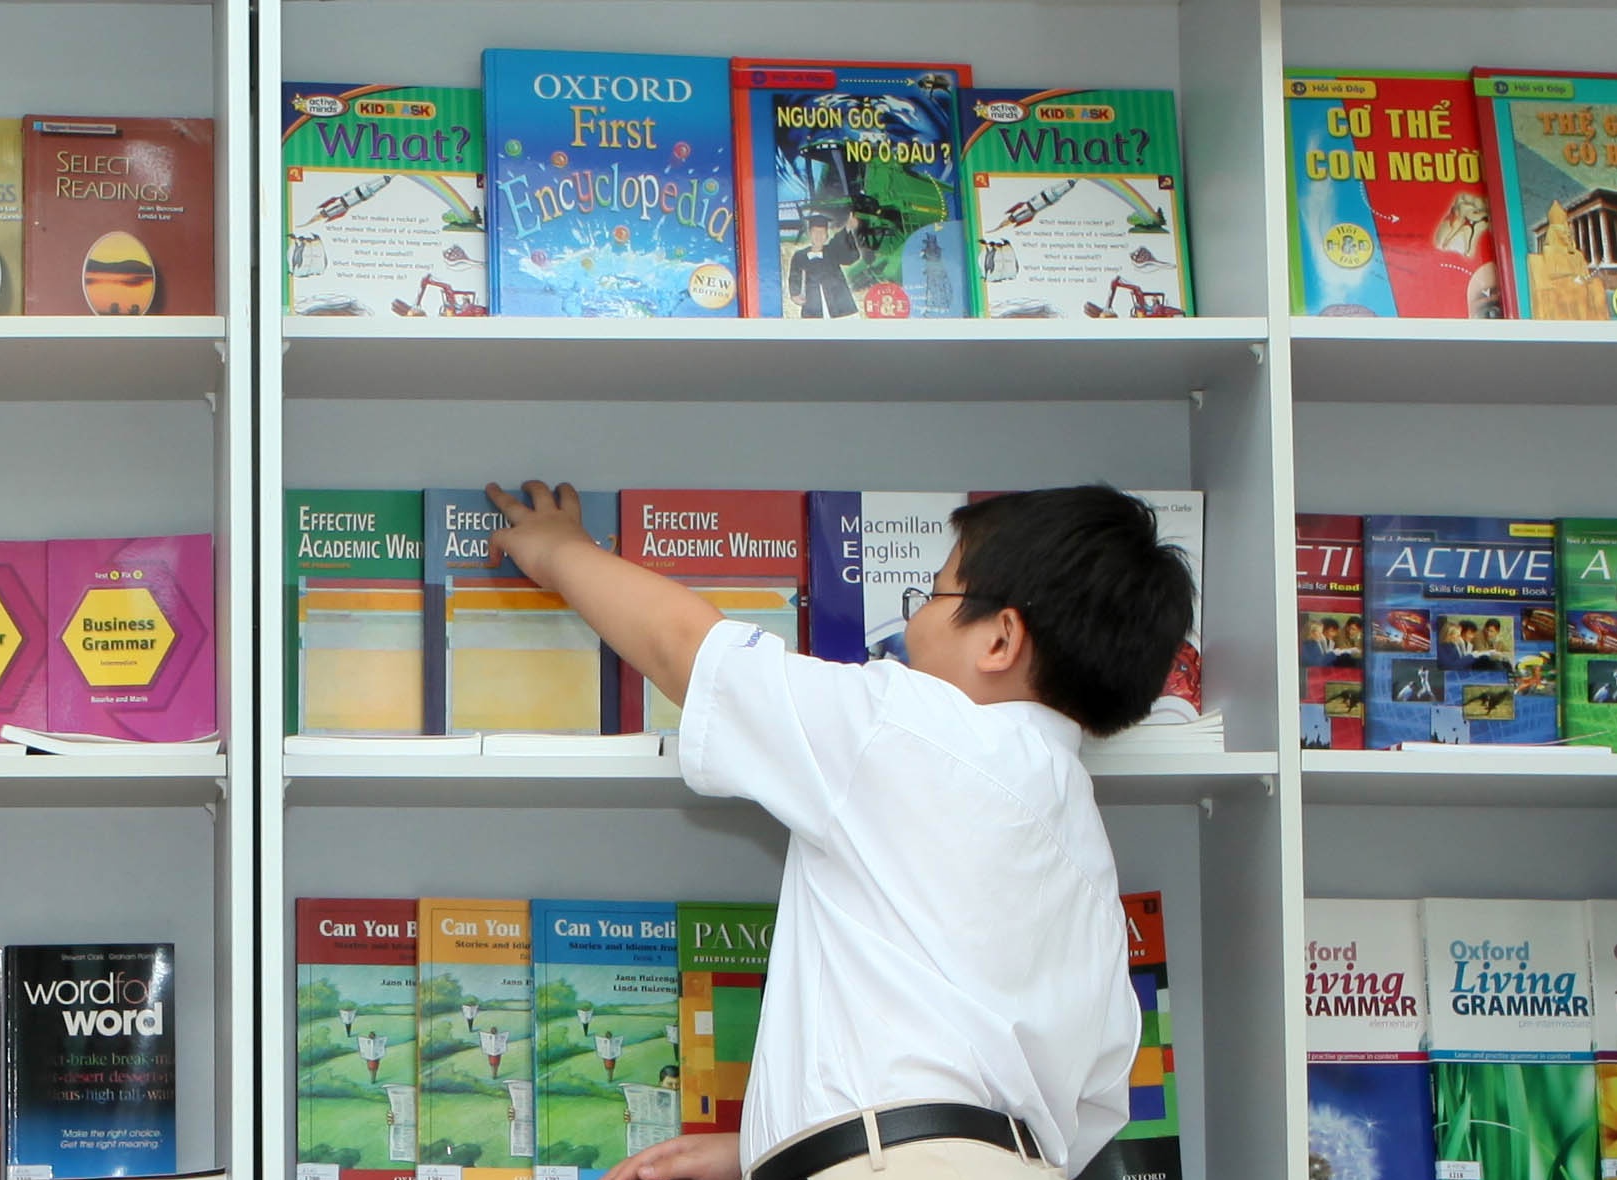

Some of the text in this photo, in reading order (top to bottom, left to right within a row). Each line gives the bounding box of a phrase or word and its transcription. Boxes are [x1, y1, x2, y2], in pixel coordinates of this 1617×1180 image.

[533, 74, 692, 103] OXFORD
[571, 105, 657, 150] First
[318, 122, 470, 162] What?
[999, 127, 1150, 166] What?
[55, 151, 132, 177] SELECT
[1306, 150, 1376, 180] CON
[55, 176, 169, 202] READINGS
[500, 162, 734, 243] Encyclopedia
[693, 273, 731, 288] NEW
[642, 504, 719, 531] EFFECTIVE
[841, 515, 943, 535] Macmillan
[642, 531, 798, 559] ACADEMIC WRITING
[843, 540, 921, 563] English
[1386, 547, 1553, 582] ACTIVE
[1522, 586, 1548, 597] Book
[83, 616, 155, 633] Business
[82, 636, 157, 653] Grammar
[319, 919, 400, 938] Can You
[554, 919, 635, 939] Can You
[1449, 940, 1529, 961] Oxford
[1450, 961, 1577, 1005] Living
[62, 1002, 163, 1036] word
[1452, 995, 1589, 1017] GRAMMAR
